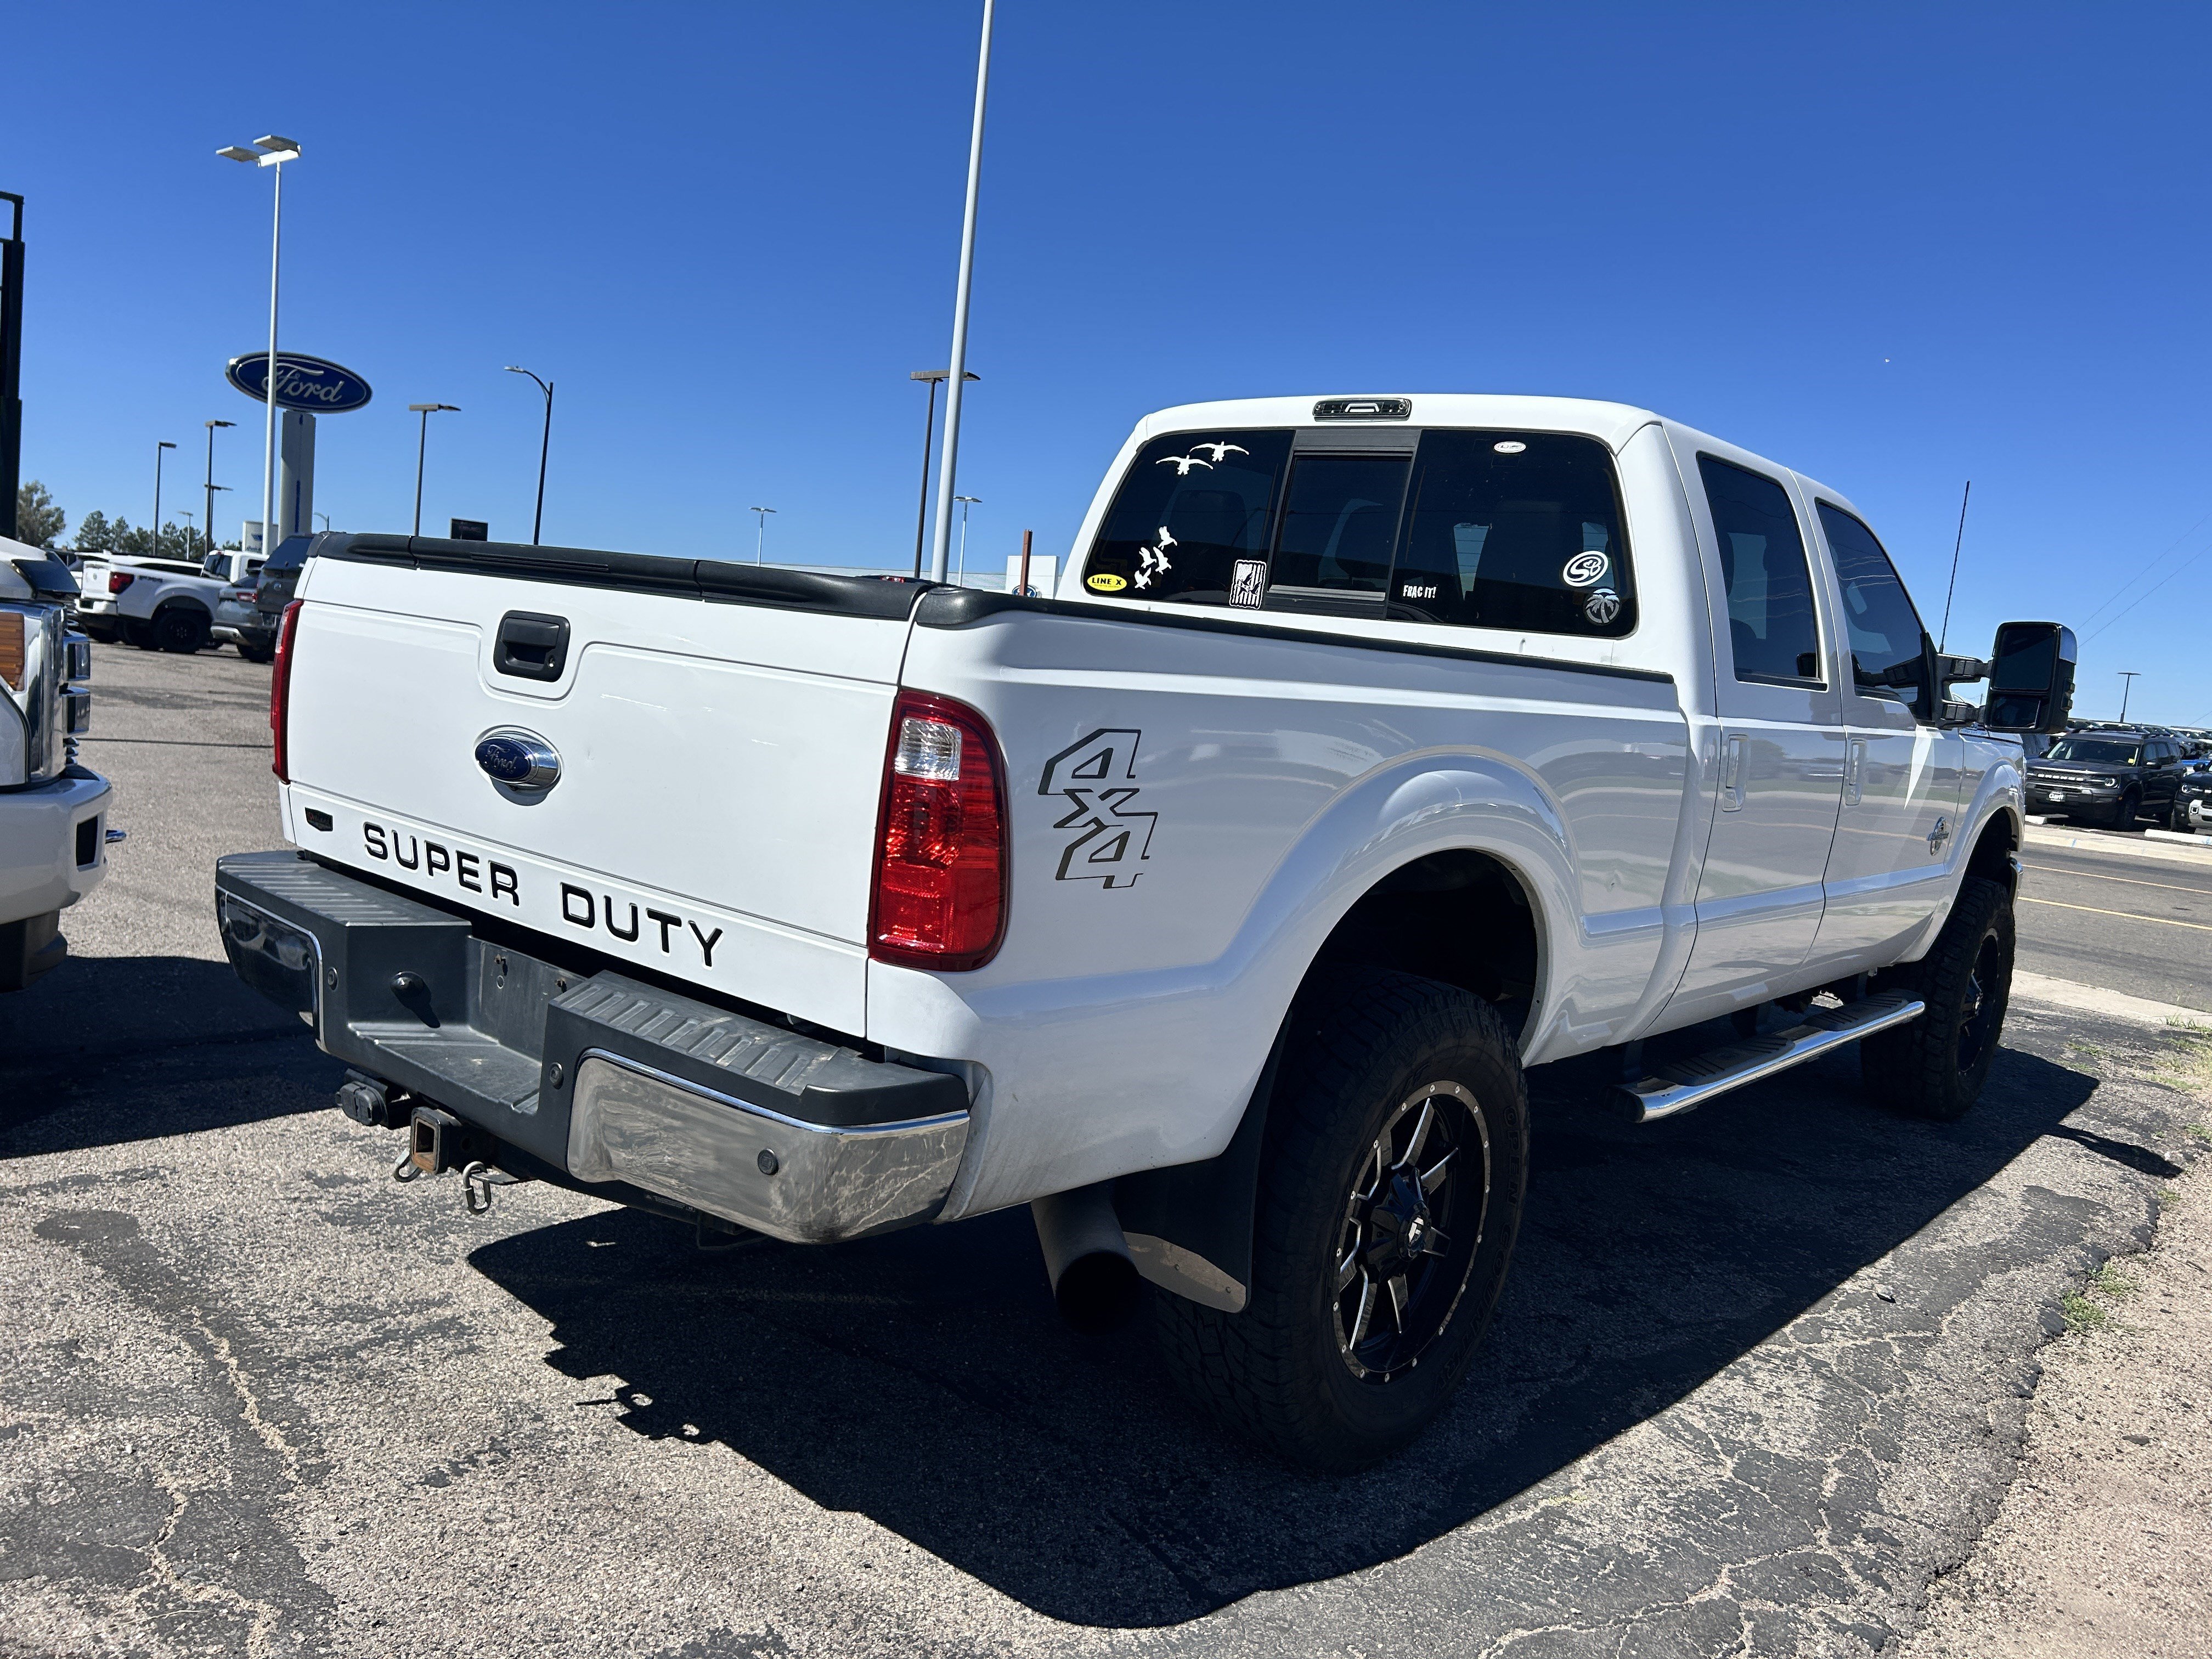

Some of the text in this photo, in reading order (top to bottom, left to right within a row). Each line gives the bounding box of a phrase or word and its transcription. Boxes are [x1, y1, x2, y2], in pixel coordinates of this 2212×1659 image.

[261, 362, 345, 402] Ford
[1403, 585, 1437, 599] FRAC IT!
[484, 744, 518, 774] Ford
[363, 822, 724, 968] SUPER DUTY
